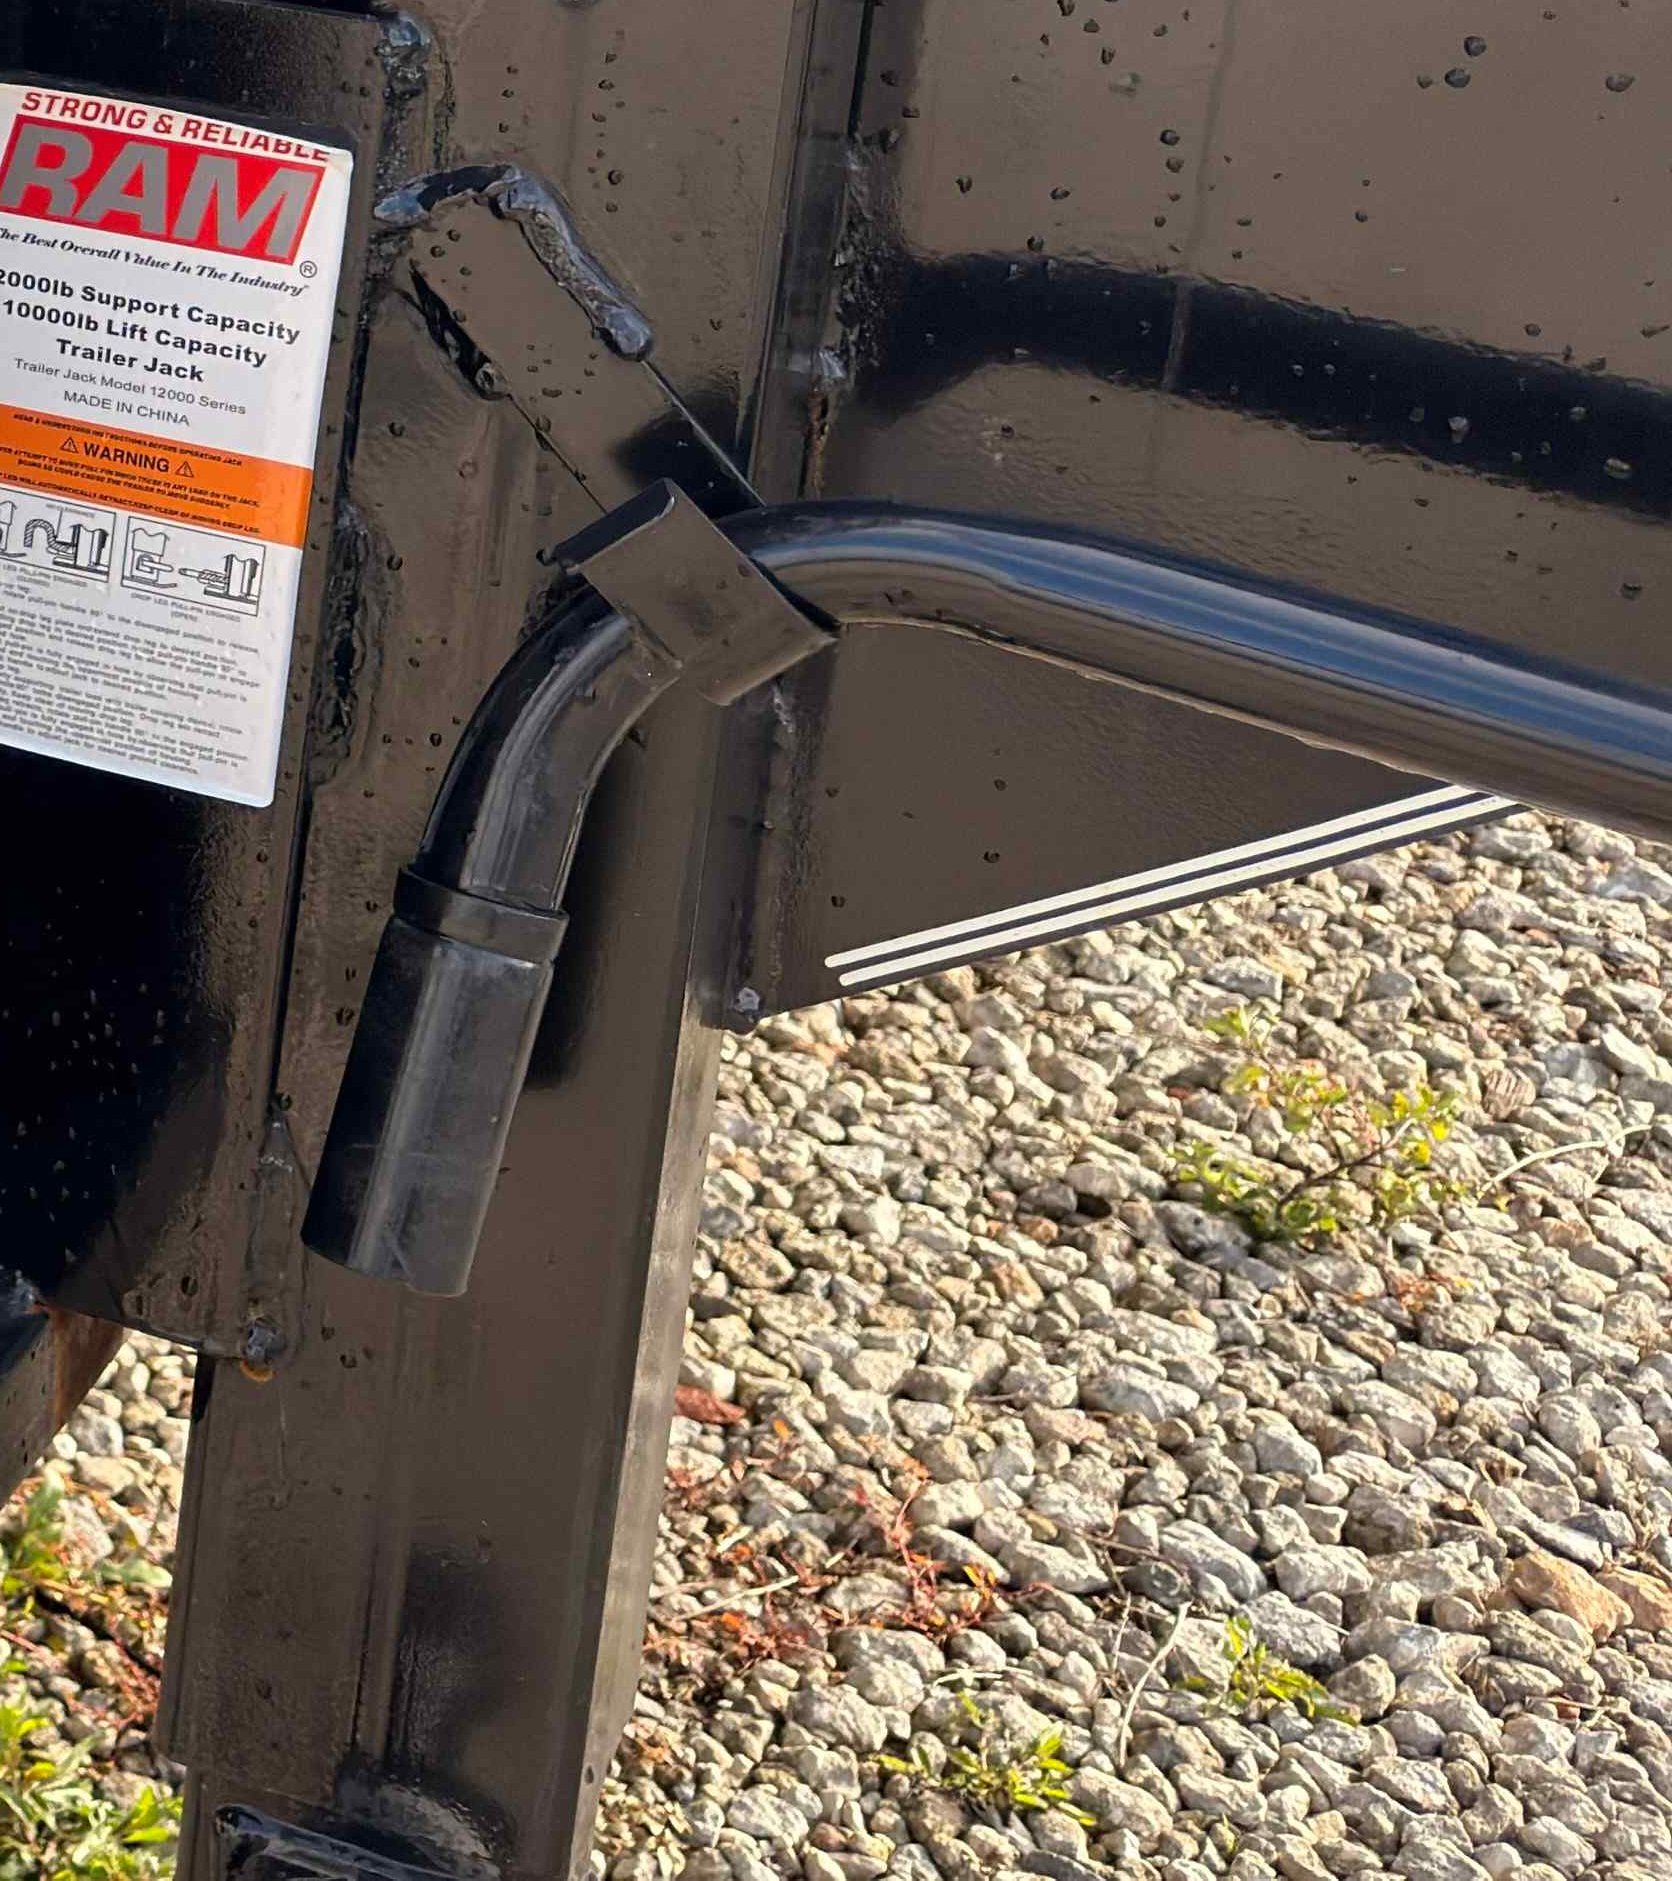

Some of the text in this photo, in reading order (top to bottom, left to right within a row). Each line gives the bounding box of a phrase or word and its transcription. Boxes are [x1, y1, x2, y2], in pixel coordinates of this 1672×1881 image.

[22, 92, 330, 162] STRONG & RELIABLE
[23, 233, 58, 249] Best
[61, 240, 120, 261] Overall
[125, 251, 169, 270] Value
[173, 260, 191, 274] In
[197, 266, 227, 282] The
[3, 299, 267, 367] 10000lb Lift Capacity
[81, 286, 179, 319] Support
[187, 306, 300, 345] Capacity
[14, 358, 247, 415] Trailer Jack Model 12000 Series
[56, 338, 204, 382] Trailer Jack
[64, 390, 190, 427] MADE IN CHINA
[83, 442, 170, 473] WARNING
